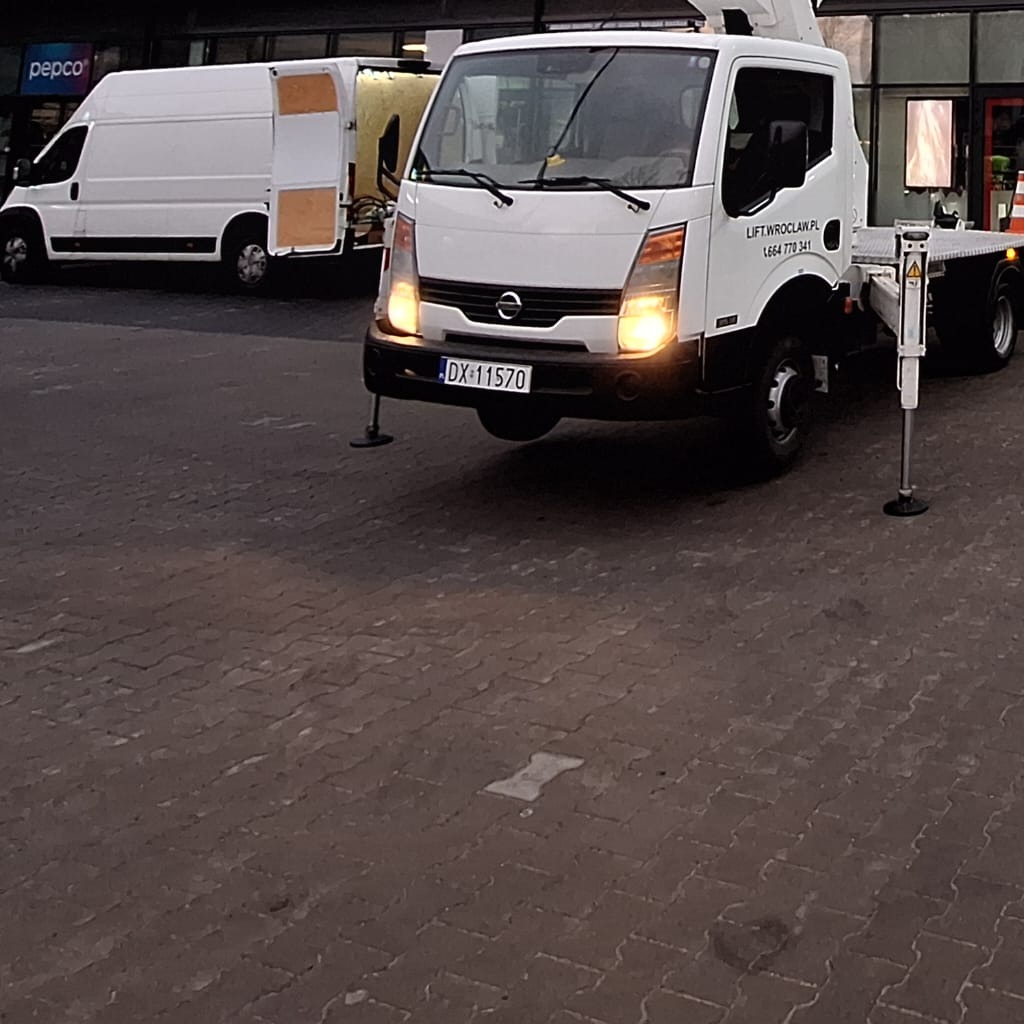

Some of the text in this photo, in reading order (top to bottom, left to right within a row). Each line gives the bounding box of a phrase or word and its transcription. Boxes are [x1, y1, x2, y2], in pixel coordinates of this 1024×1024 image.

[29, 61, 83, 80] pepco
[746, 220, 820, 239] LIFT.WROCLAW.PL
[767, 239, 812, 258] 664 770 341
[448, 361, 526, 390] DX 11570
